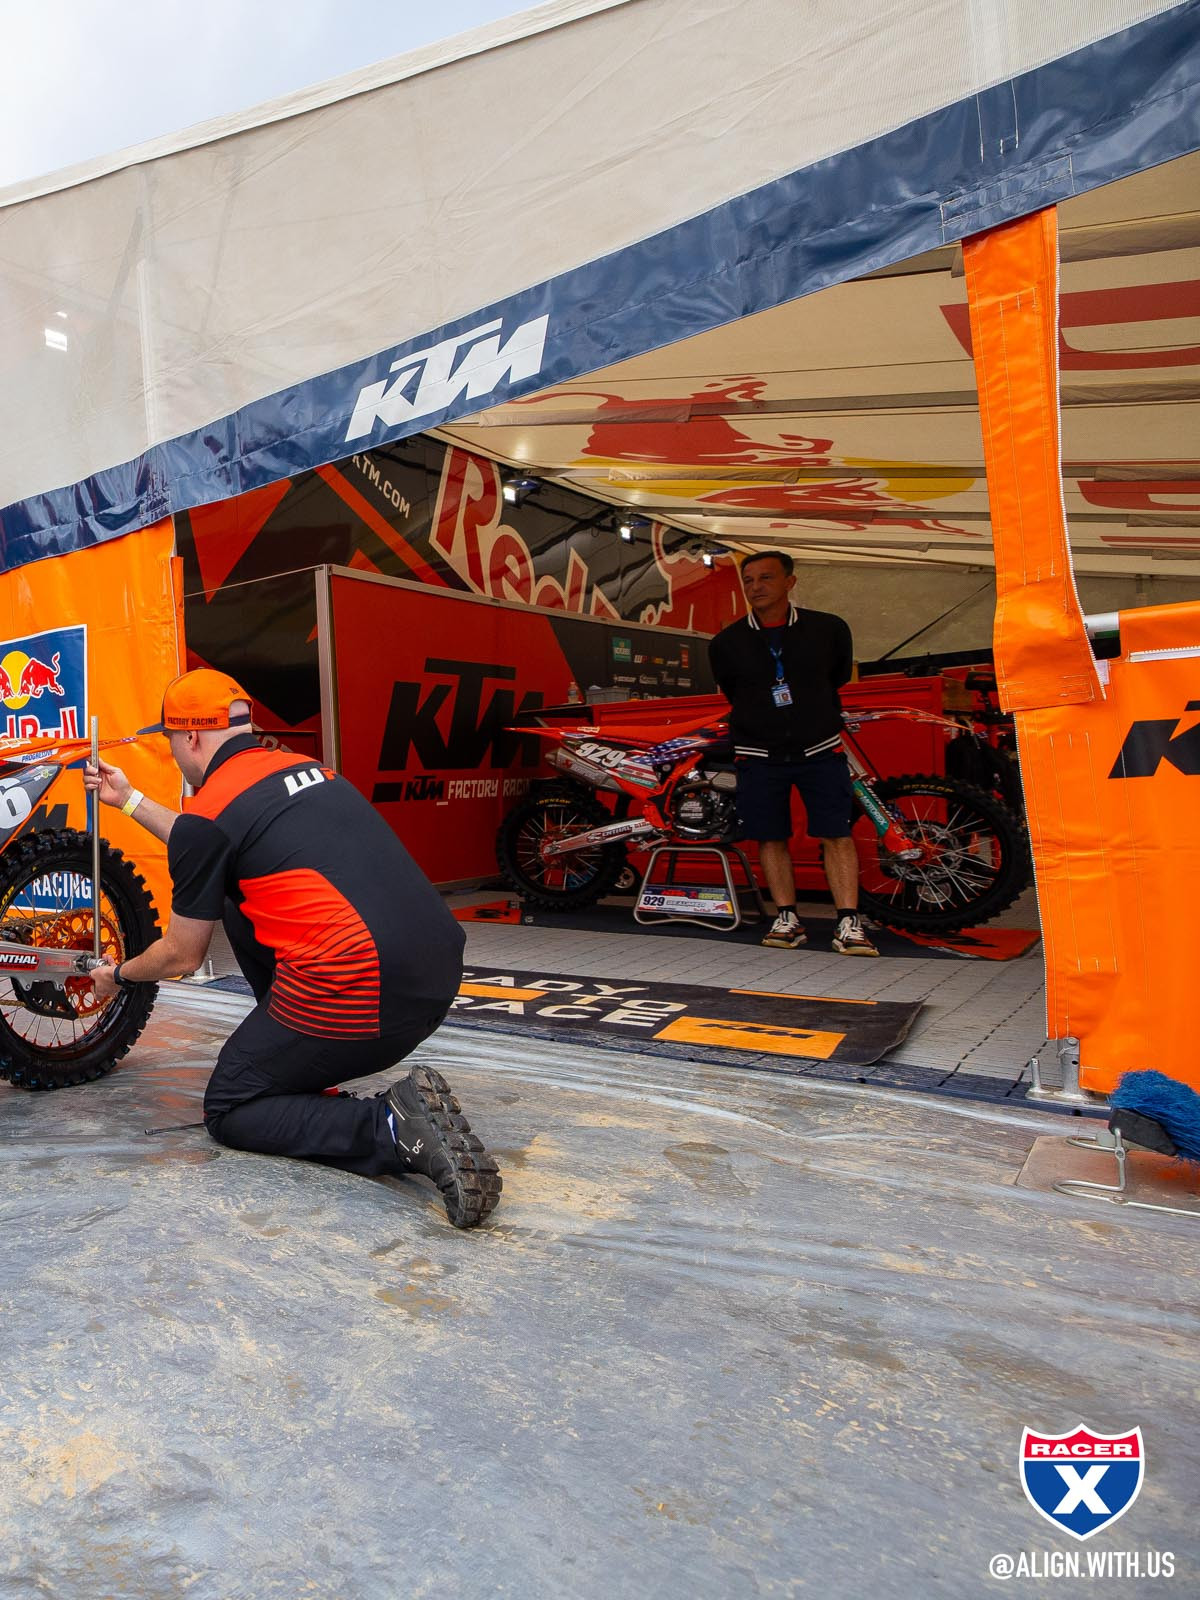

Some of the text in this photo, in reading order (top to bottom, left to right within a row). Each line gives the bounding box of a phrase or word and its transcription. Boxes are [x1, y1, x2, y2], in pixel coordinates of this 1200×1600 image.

[344, 313, 550, 443] KTM
[191, 717, 218, 726] RACING
[377, 657, 544, 771] KTM
[575, 742, 626, 768] 929
[284, 767, 336, 796] WP
[404, 775, 445, 801] KTM
[448, 780, 498, 799] FACTORY
[33, 873, 92, 900] RACING
[643, 896, 665, 906] 929
[463, 972, 648, 996] ADY
[571, 993, 688, 1013] TO
